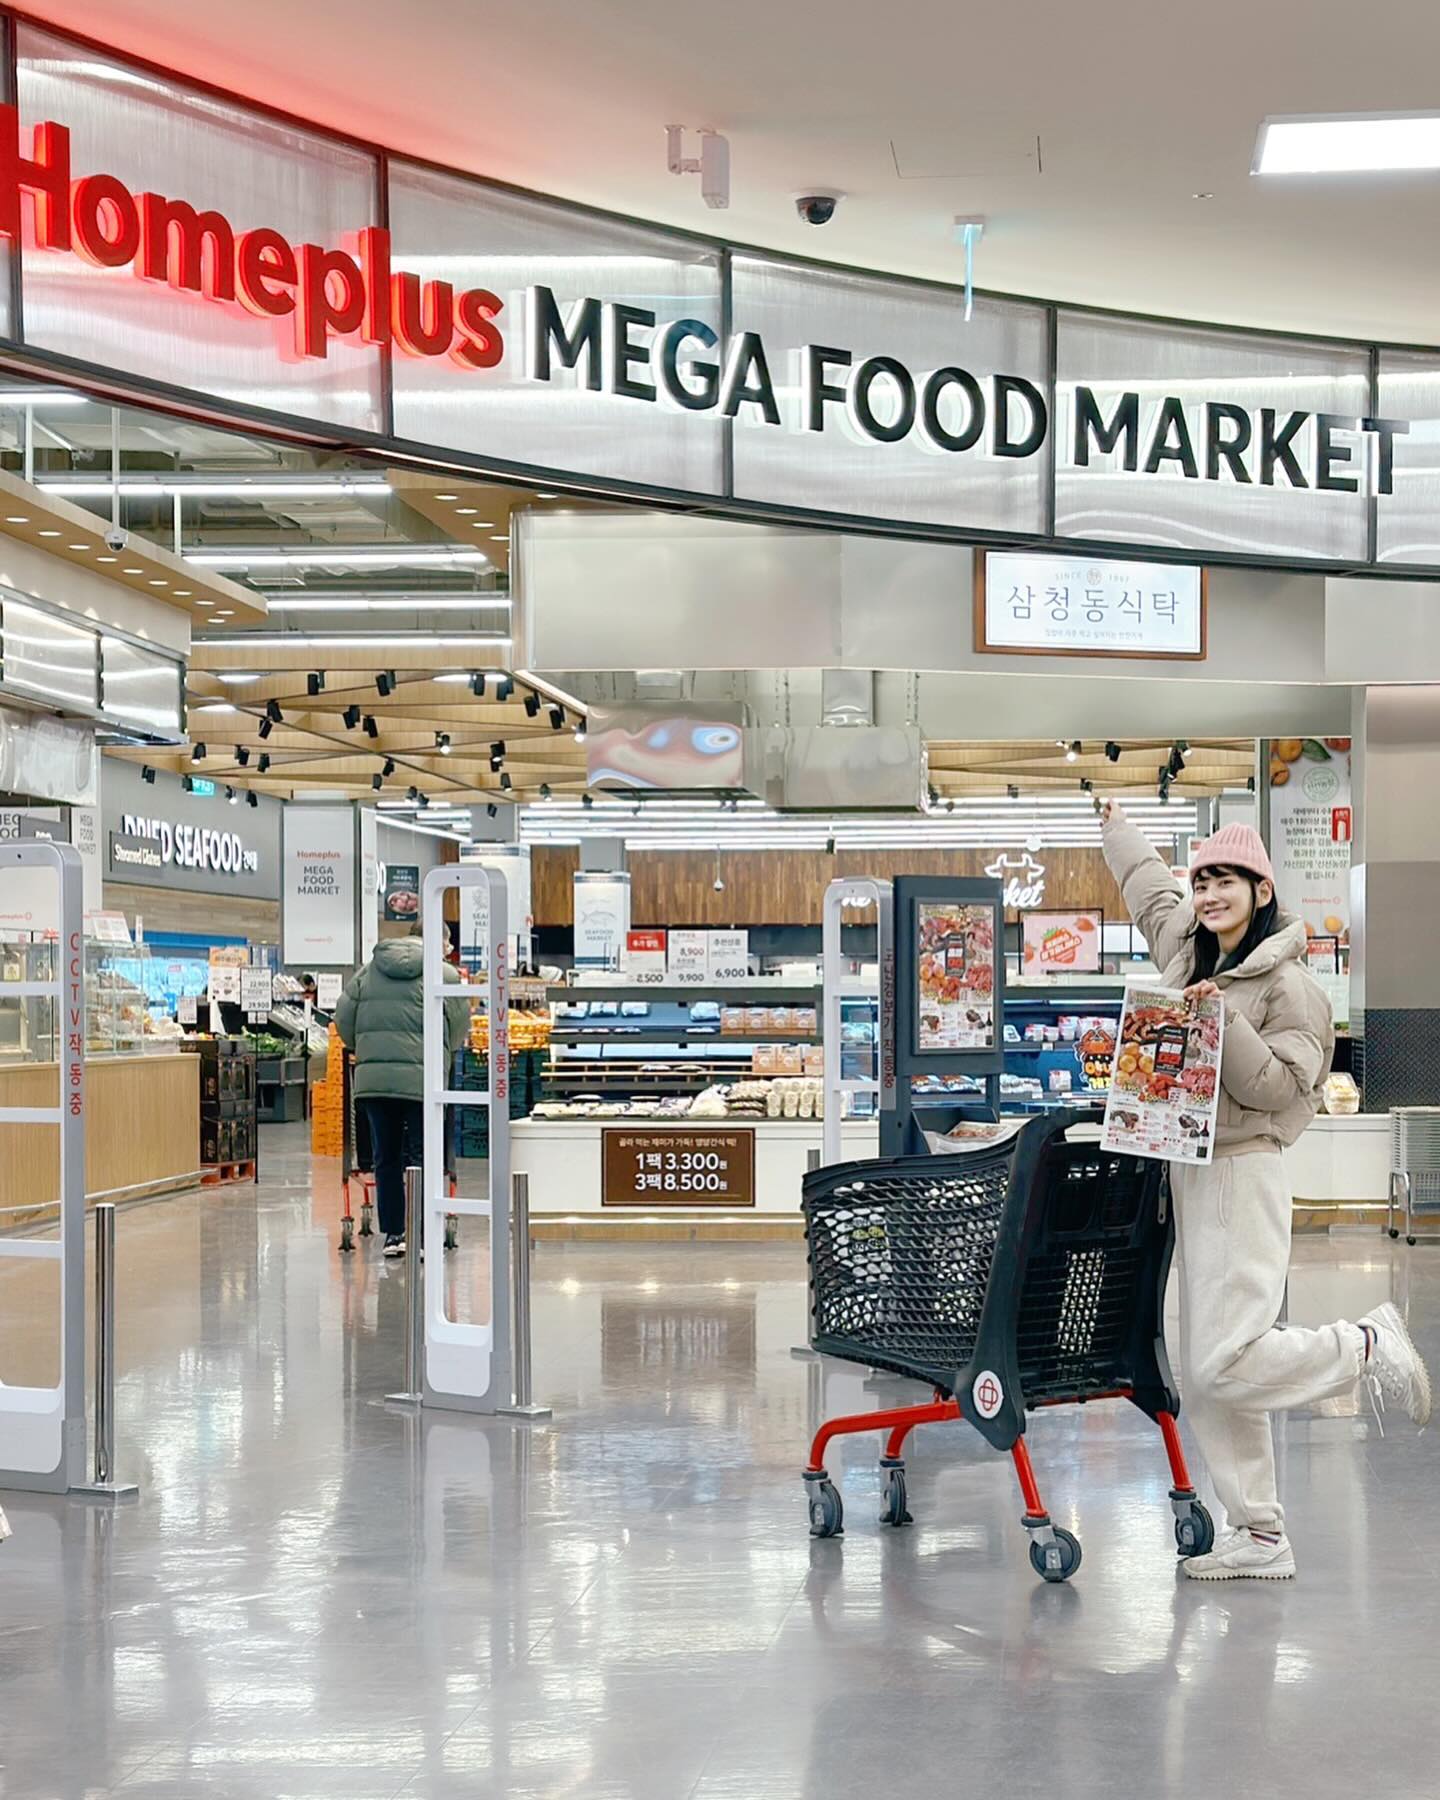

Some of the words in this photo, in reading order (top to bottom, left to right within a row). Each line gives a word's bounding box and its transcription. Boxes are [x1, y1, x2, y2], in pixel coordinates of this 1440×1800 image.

[0, 104, 504, 369] Homeplus
[528, 284, 782, 426] MEGA
[799, 343, 1048, 460] FOOD
[1074, 386, 1410, 496] MARKET
[1055, 571, 1081, 581] SINCE
[1007, 584, 1180, 625] 삼청동식탁
[175, 823, 242, 873] SEAFOOD
[297, 850, 341, 860] Homeplus
[303, 865, 334, 875] MEGA
[303, 875, 335, 885] FOOD
[297, 886, 340, 895] MARKET
[678, 973, 704, 982] 9,900
[715, 968, 745, 978] 6,900
[635, 1153, 662, 1170] 1팩
[634, 1173, 662, 1190] 3팩
